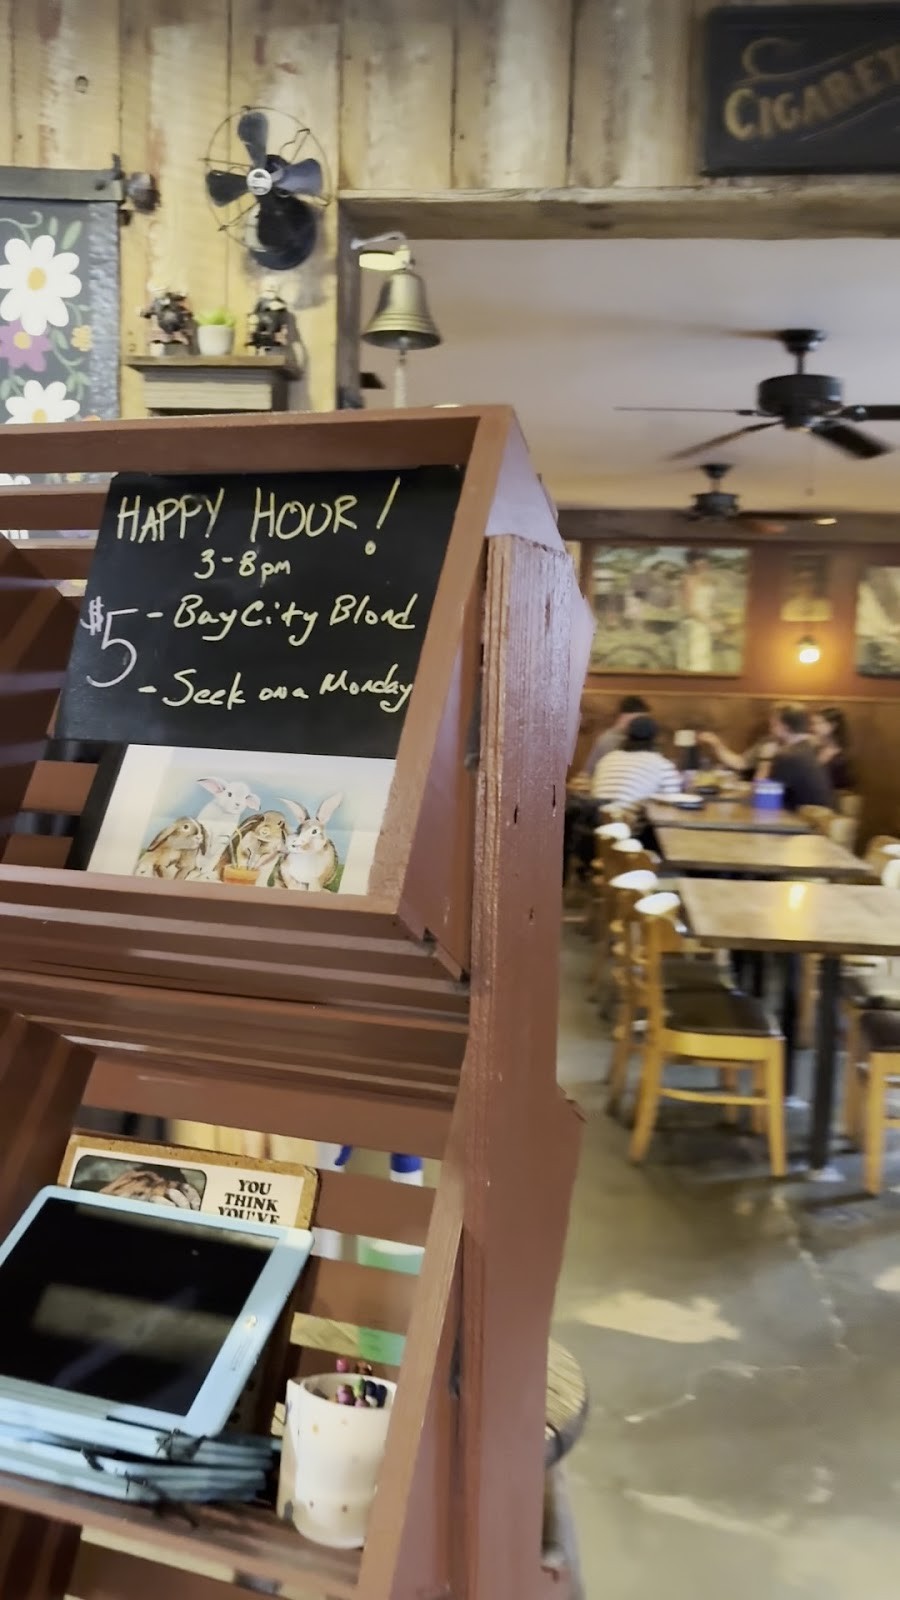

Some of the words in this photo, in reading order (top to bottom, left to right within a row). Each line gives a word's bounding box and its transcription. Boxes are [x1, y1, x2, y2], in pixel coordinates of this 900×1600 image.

[117, 487, 224, 543] HAPPY
[80, 596, 139, 688] $5
[329, 593, 418, 629] Blond
[162, 669, 246, 710] Seek
[319, 663, 413, 713] Monday
[225, 1192, 279, 1212] THINK
[239, 1179, 272, 1196] YOU
[218, 1206, 280, 1224] YOU'VE
